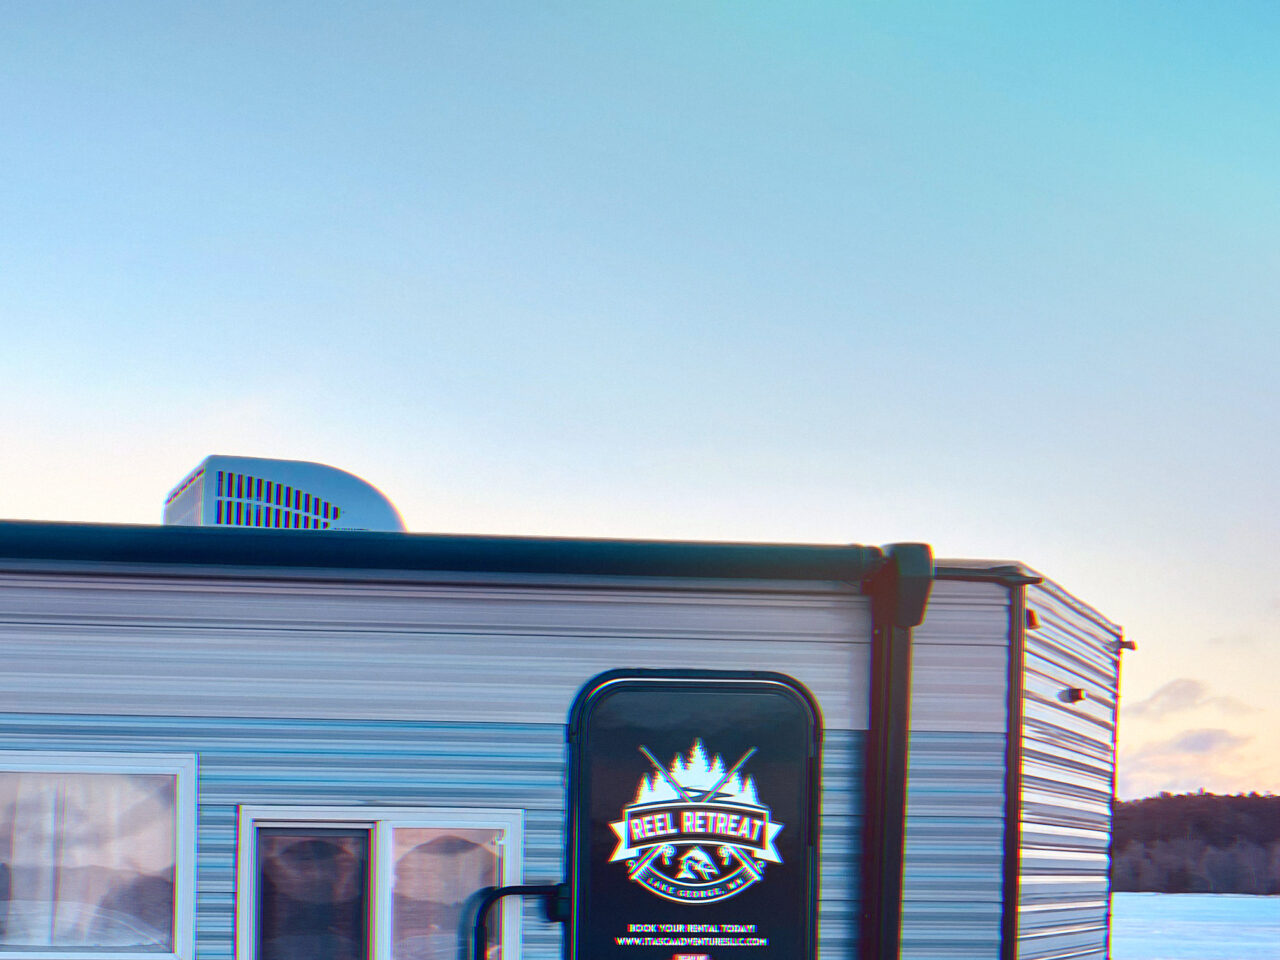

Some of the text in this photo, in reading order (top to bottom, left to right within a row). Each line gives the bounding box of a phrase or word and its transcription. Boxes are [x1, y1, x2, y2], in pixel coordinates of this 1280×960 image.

[630, 811, 765, 841] REEL RETREAT
[648, 877, 744, 898] LAKE GEORGE, MN
[629, 924, 756, 933] BOOK YOUR RENTAL TODAY!
[616, 937, 768, 947] WWW.ITASCAADVENTURESLLC.COM
